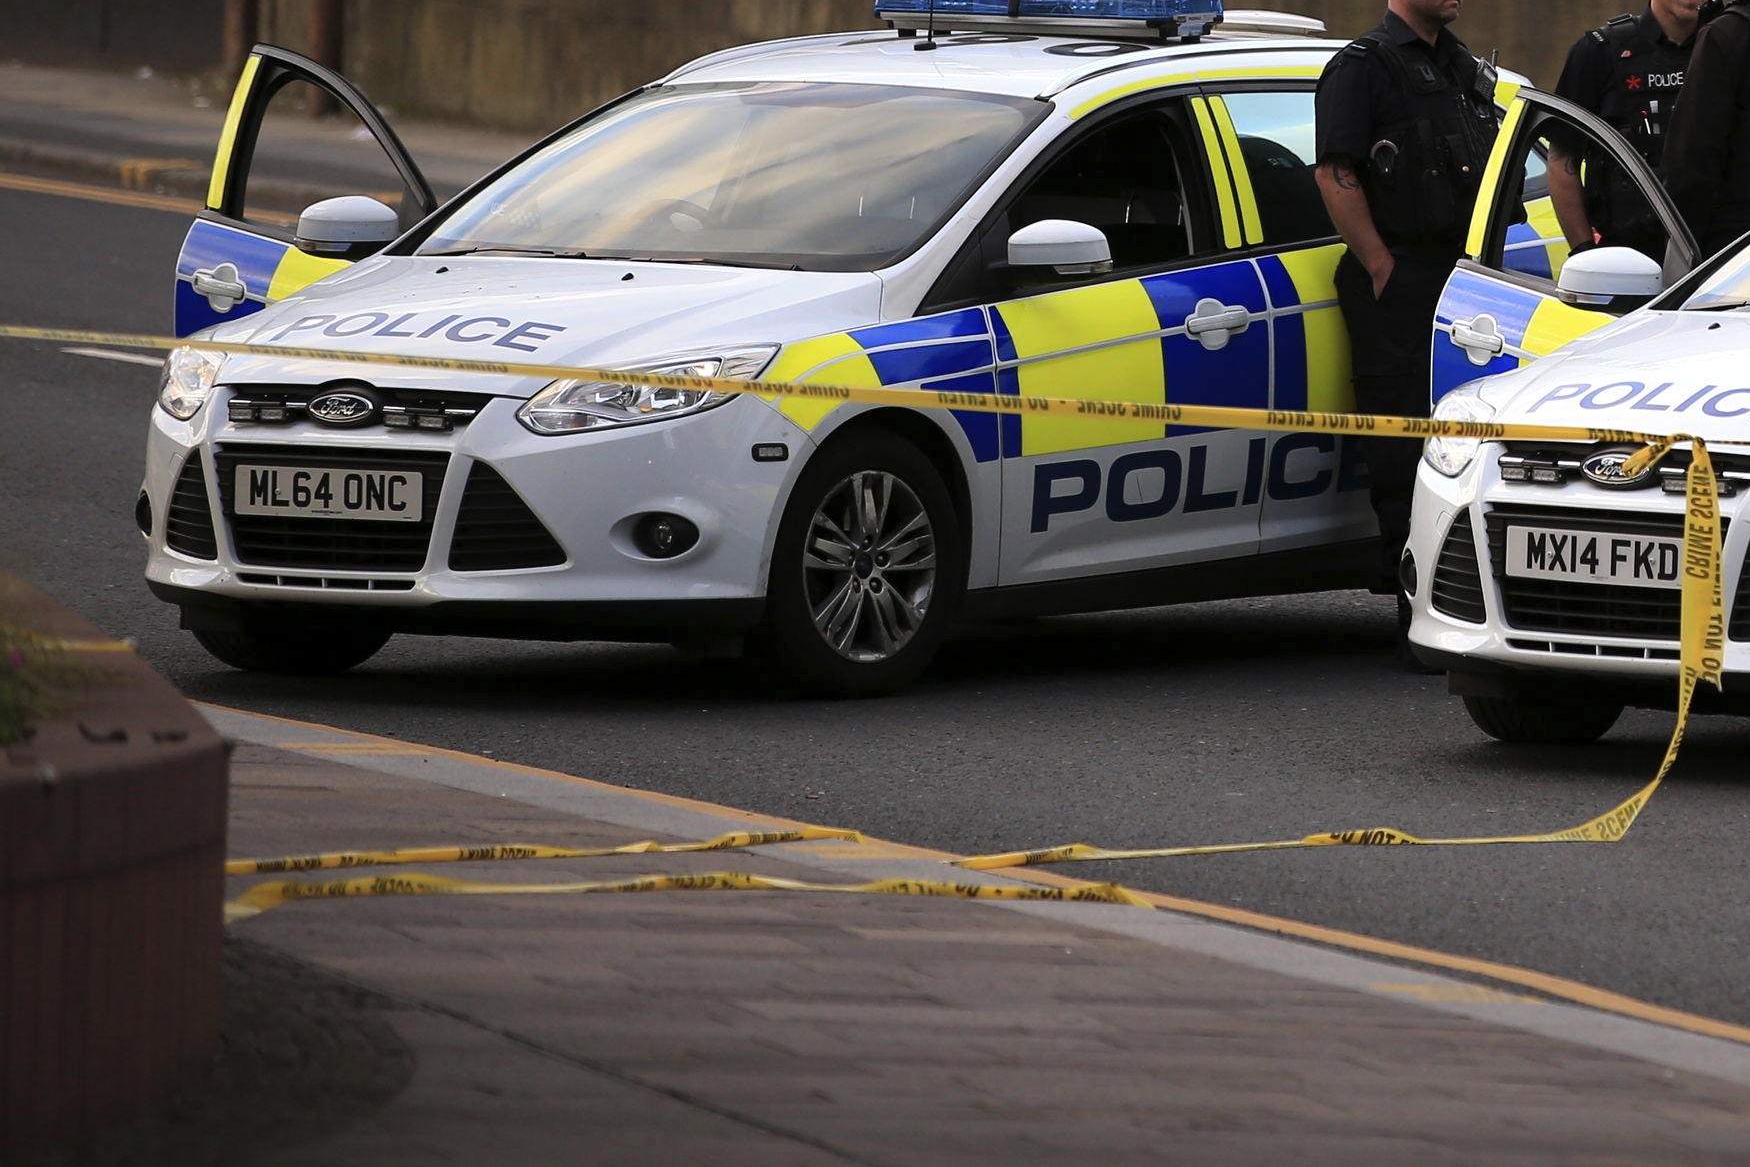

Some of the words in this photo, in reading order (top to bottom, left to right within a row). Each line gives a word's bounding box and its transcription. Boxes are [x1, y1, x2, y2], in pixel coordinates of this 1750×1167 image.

[1648, 71, 1684, 87] POLICE
[268, 312, 568, 353] POLICE
[320, 397, 358, 415] Ford
[249, 469, 333, 509] ML64
[343, 473, 407, 512] ONC
[1526, 531, 1599, 575] MX14
[1610, 538, 1679, 581] FKD
